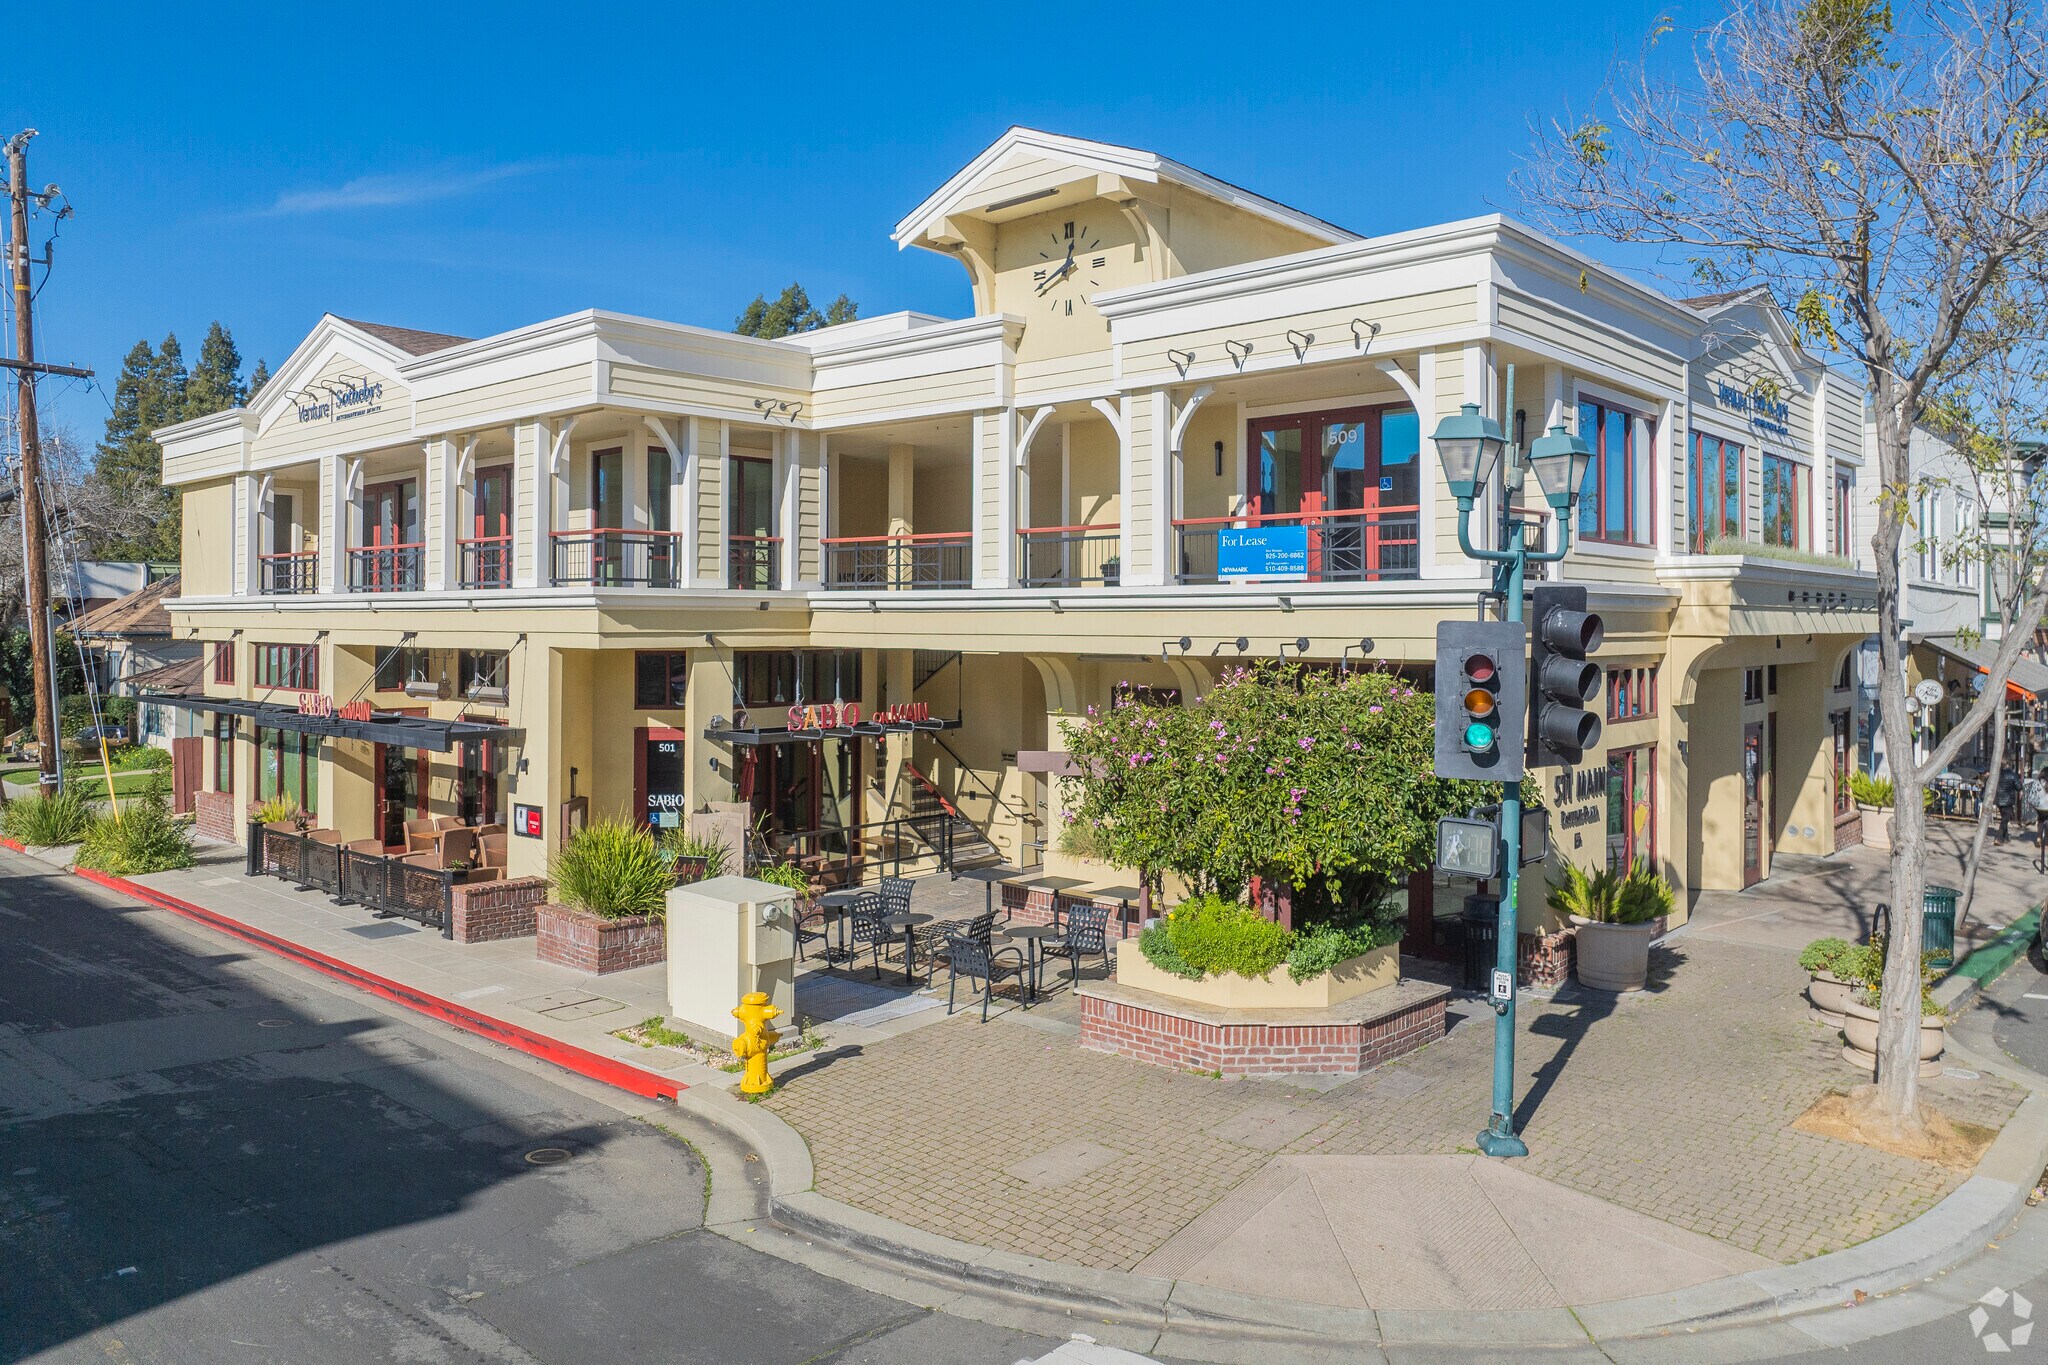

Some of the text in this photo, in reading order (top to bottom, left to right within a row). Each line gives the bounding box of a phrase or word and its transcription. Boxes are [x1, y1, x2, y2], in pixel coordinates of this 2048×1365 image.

[298, 402, 330, 423] Venture
[1329, 429, 1358, 445] 509
[1222, 534, 1267, 547] For Lease
[347, 700, 371, 722] MAIN
[890, 702, 929, 724] MAIN
[658, 743, 676, 752] 501
[1576, 766, 1606, 799] MAIN
